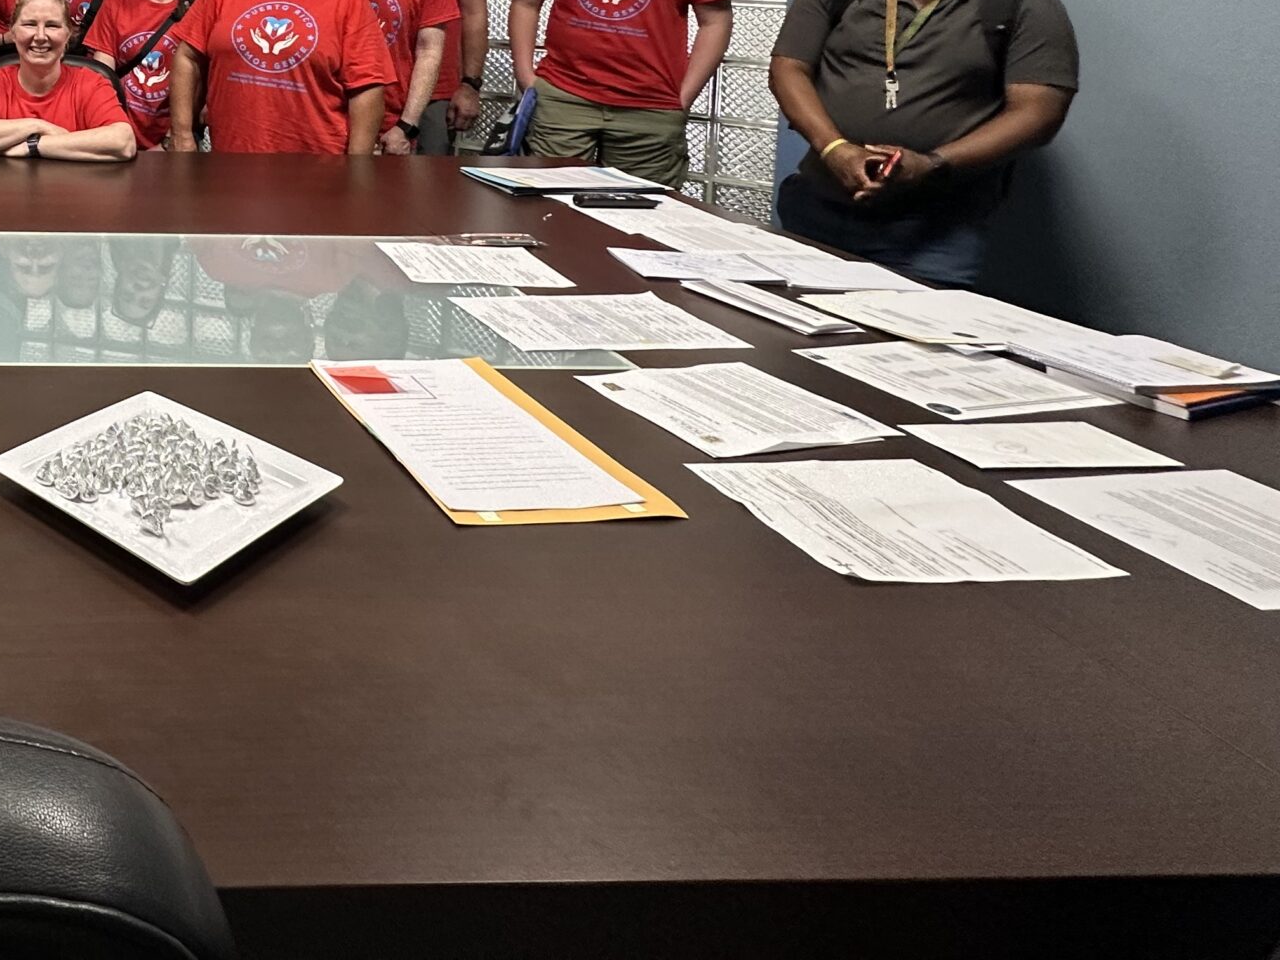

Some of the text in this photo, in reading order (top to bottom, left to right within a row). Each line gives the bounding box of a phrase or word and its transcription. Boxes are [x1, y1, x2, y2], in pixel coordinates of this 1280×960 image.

[244, 4, 313, 28] PUERTO RICO
[122, 35, 176, 55] PUERT RIC
[237, 37, 307, 69] SOMOS GENTE
